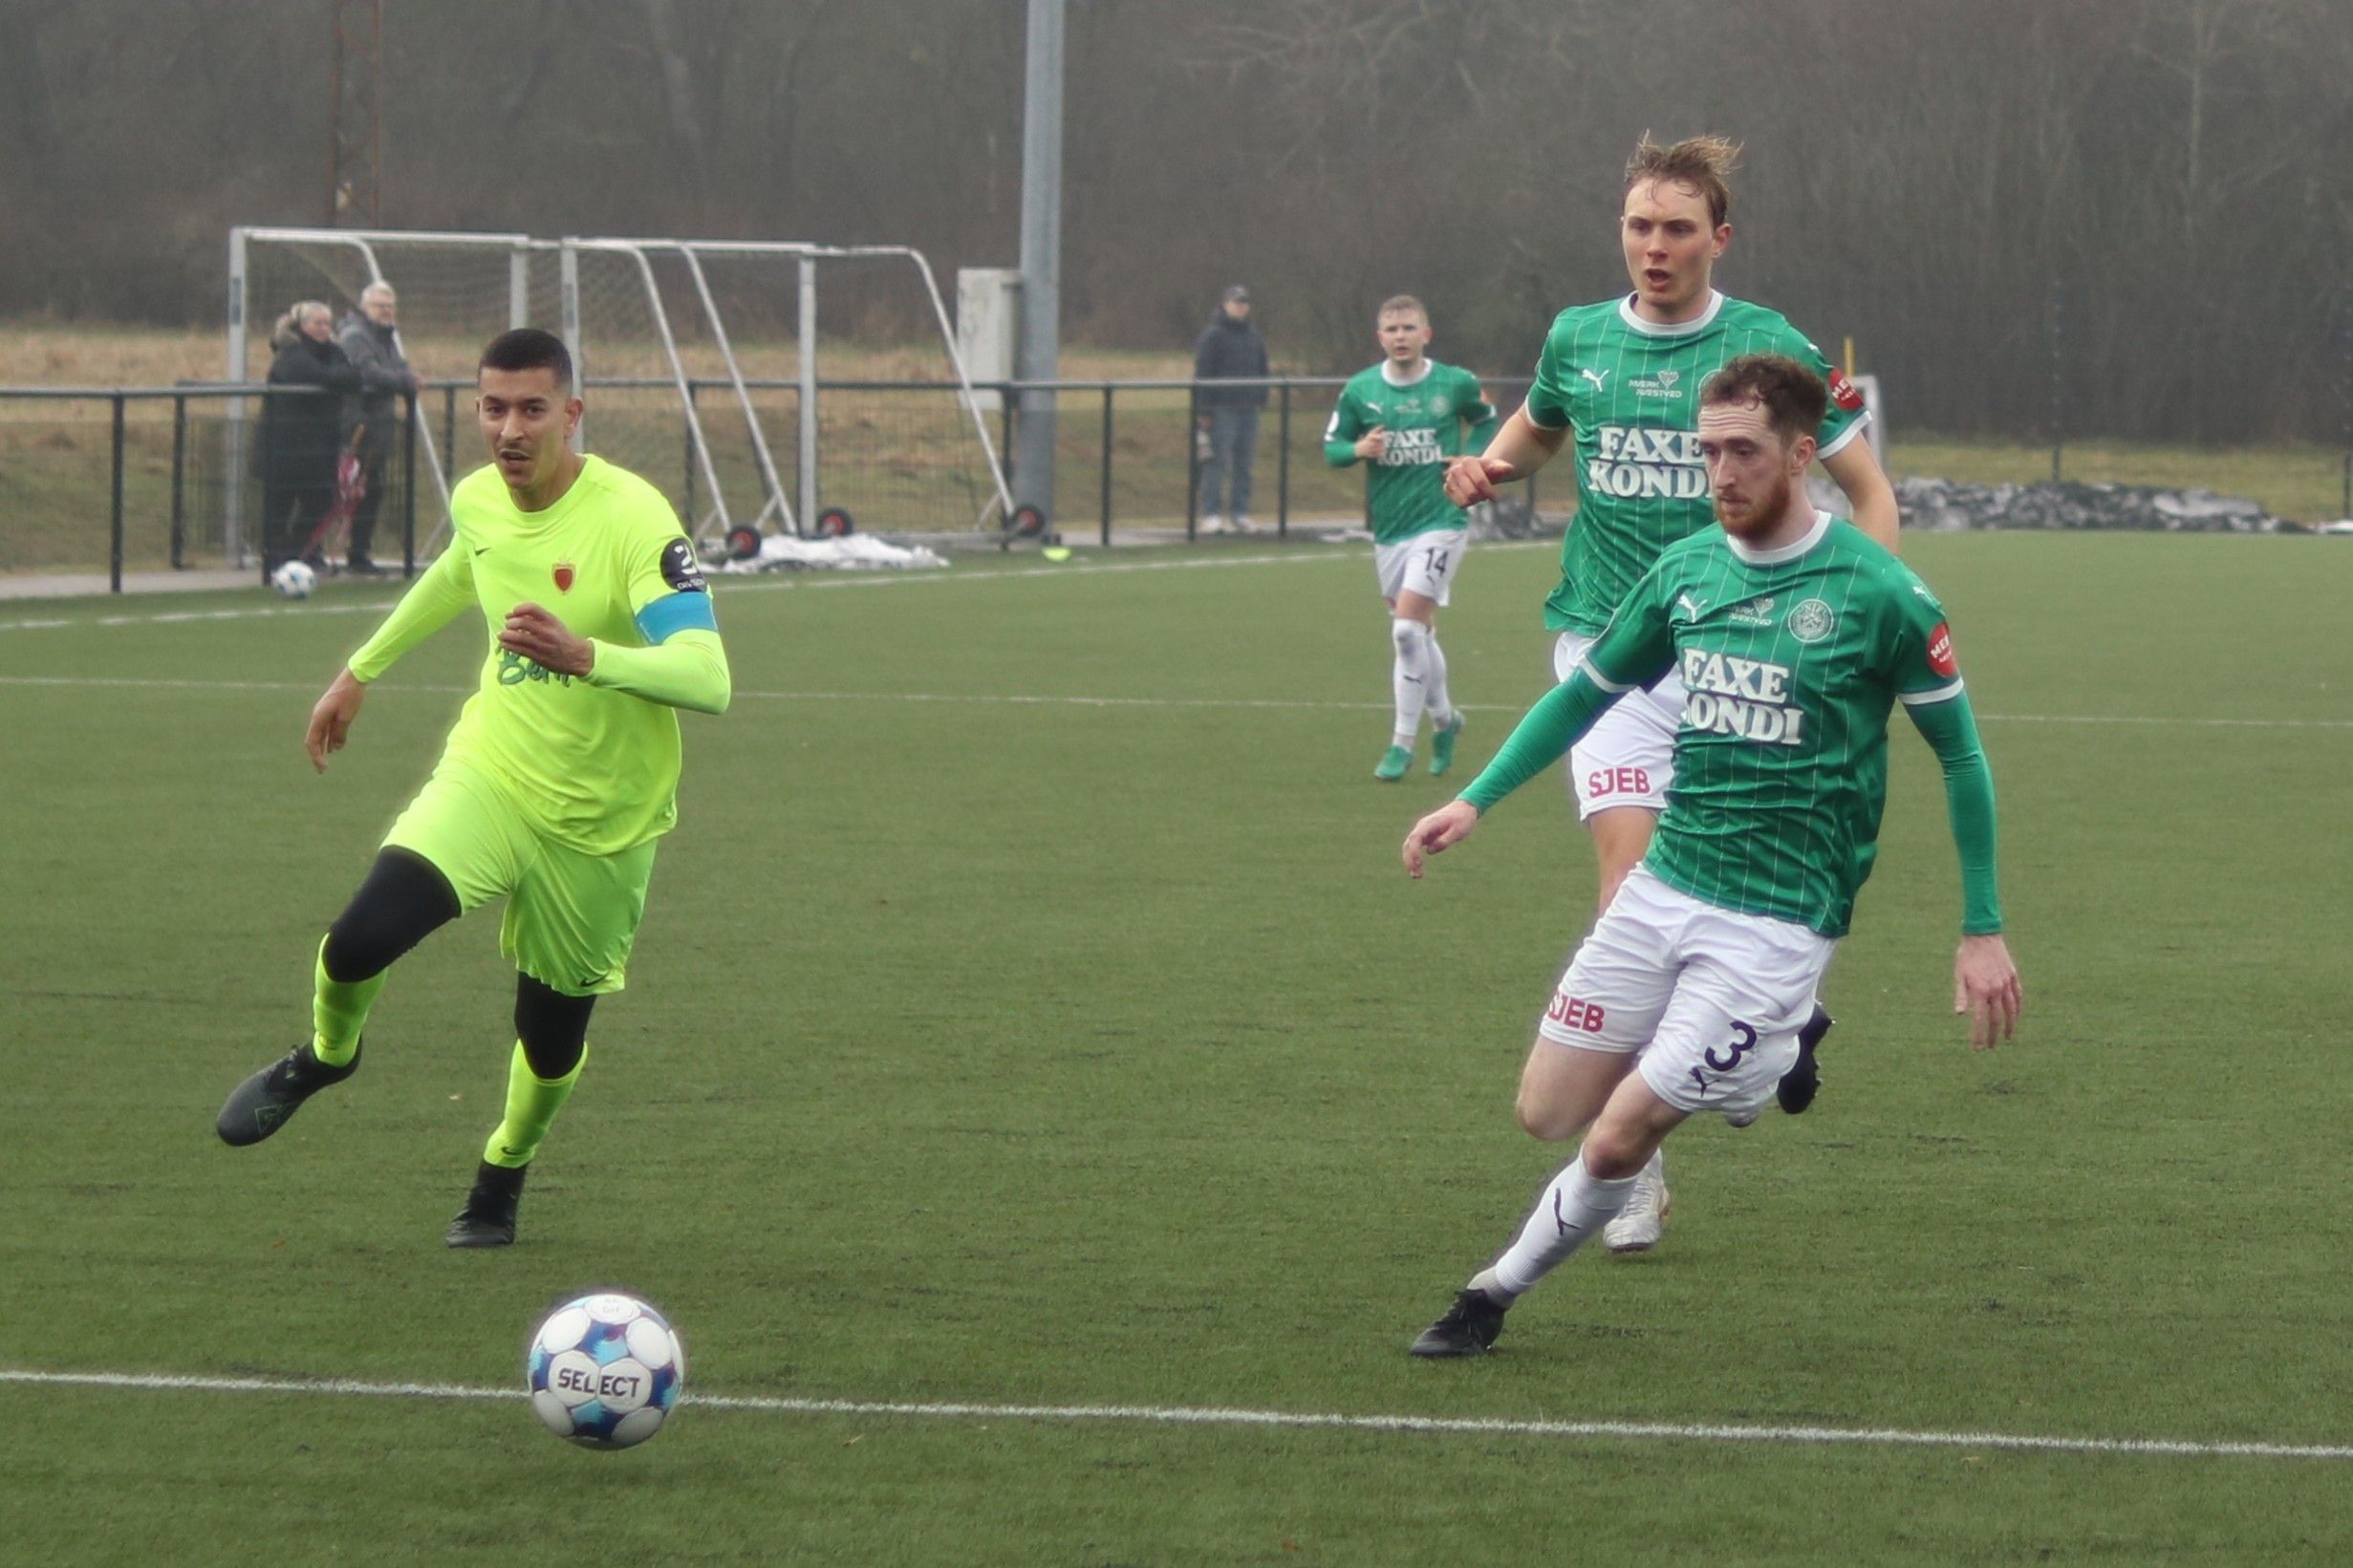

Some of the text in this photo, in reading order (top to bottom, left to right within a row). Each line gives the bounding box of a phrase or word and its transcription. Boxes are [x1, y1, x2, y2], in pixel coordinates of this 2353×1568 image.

[1384, 428, 1436, 448] FAXE
[1599, 426, 1705, 464] FAXE
[1425, 546, 1449, 577] 14
[1684, 648, 1789, 703] FAXE
[1683, 692, 1804, 744] ONDI
[1588, 767, 1651, 798] SJEB
[1704, 1020, 1757, 1072] 3
[557, 1367, 640, 1398] SELECT
